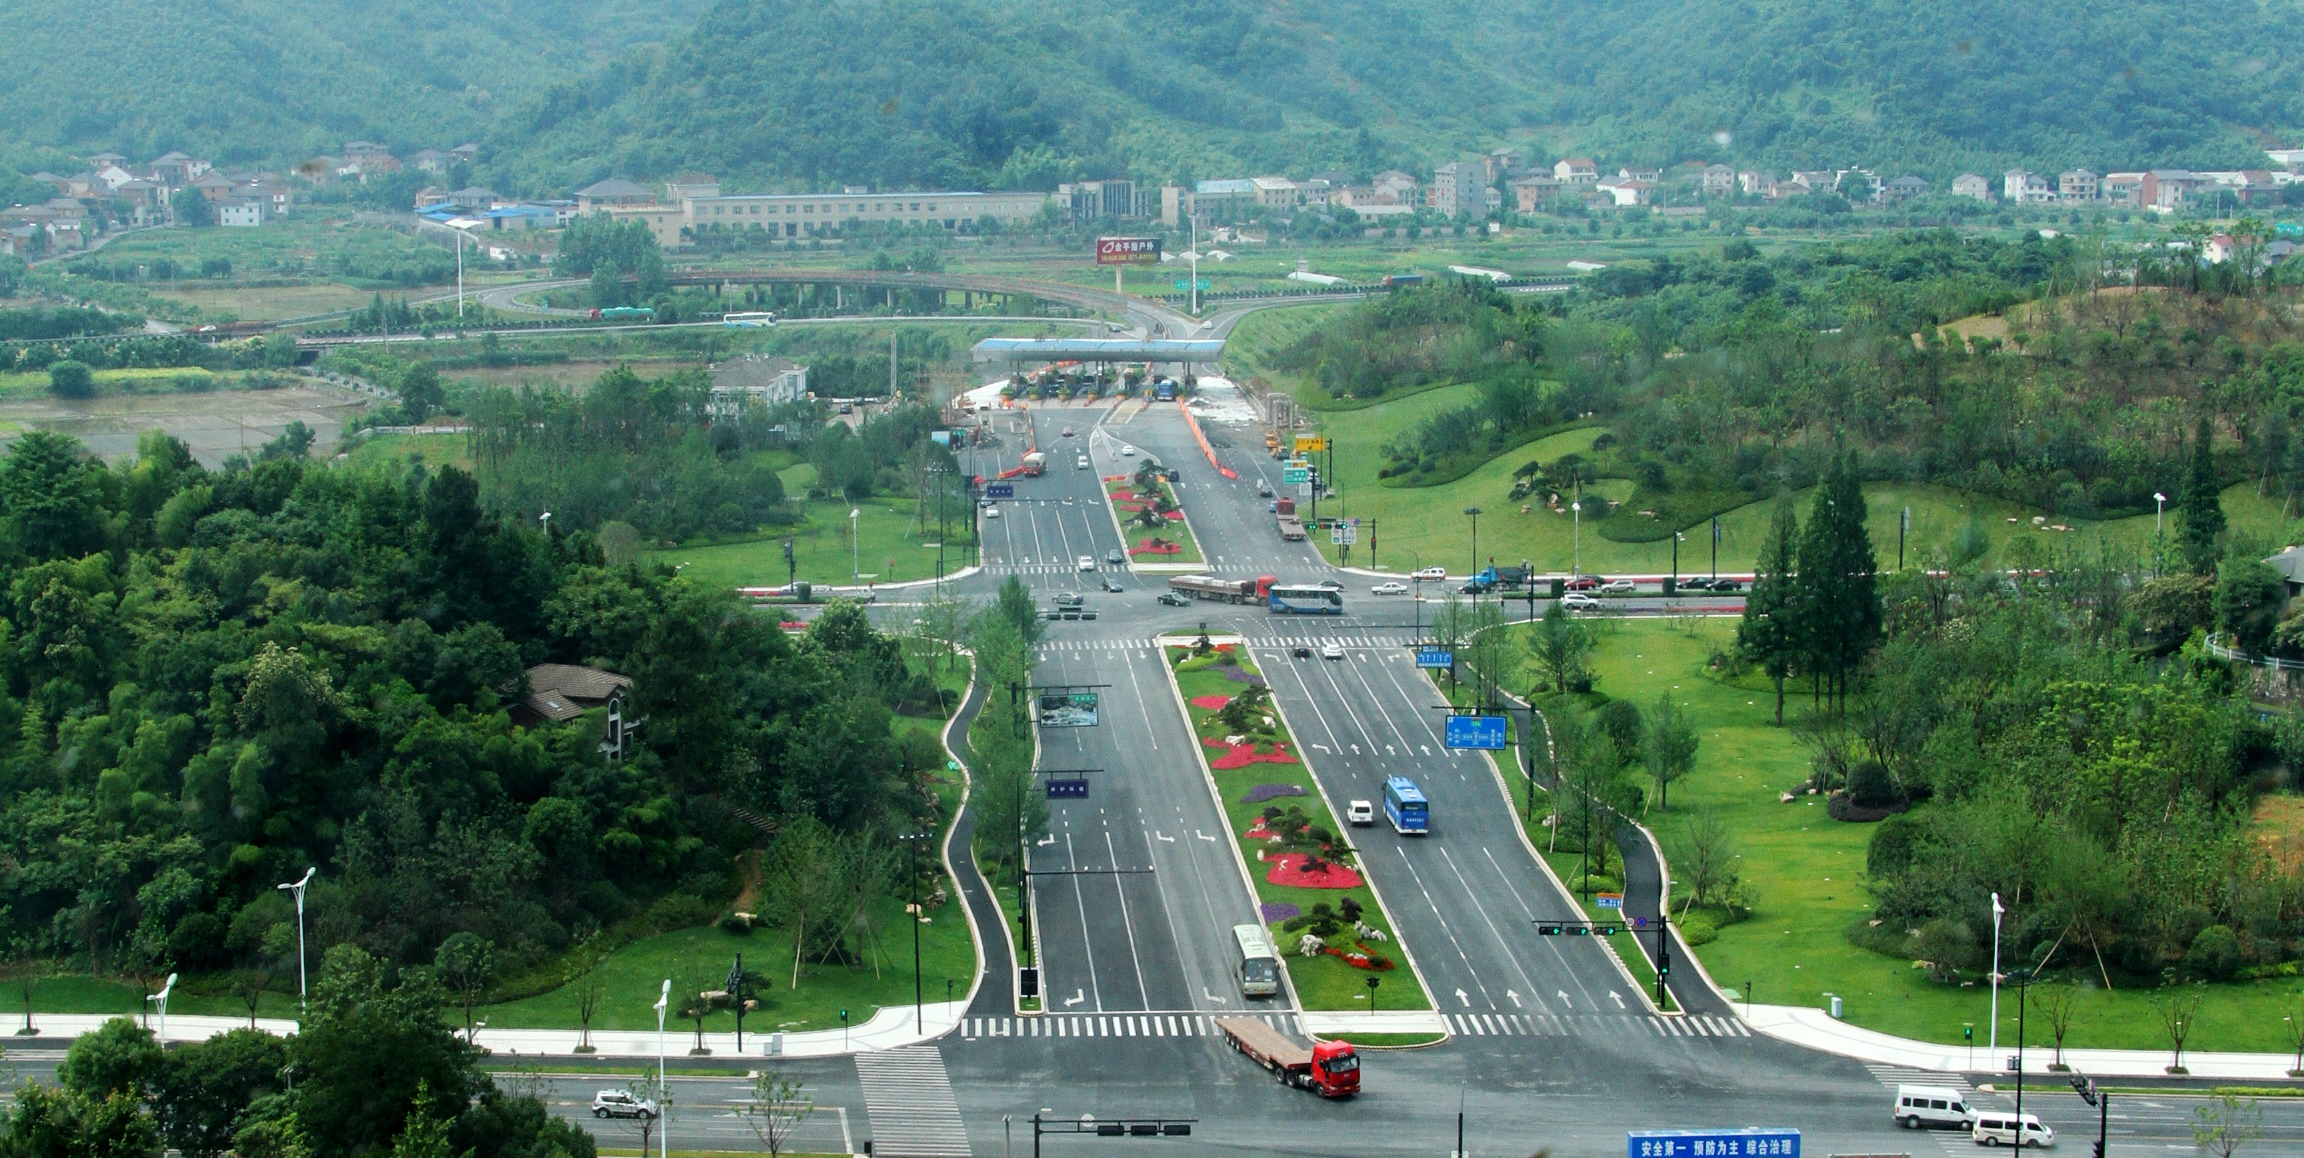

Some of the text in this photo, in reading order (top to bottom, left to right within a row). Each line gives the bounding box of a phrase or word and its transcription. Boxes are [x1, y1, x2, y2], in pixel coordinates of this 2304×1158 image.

[1641, 1139, 1792, 1157] 安全第一 预防为主 综合治理
